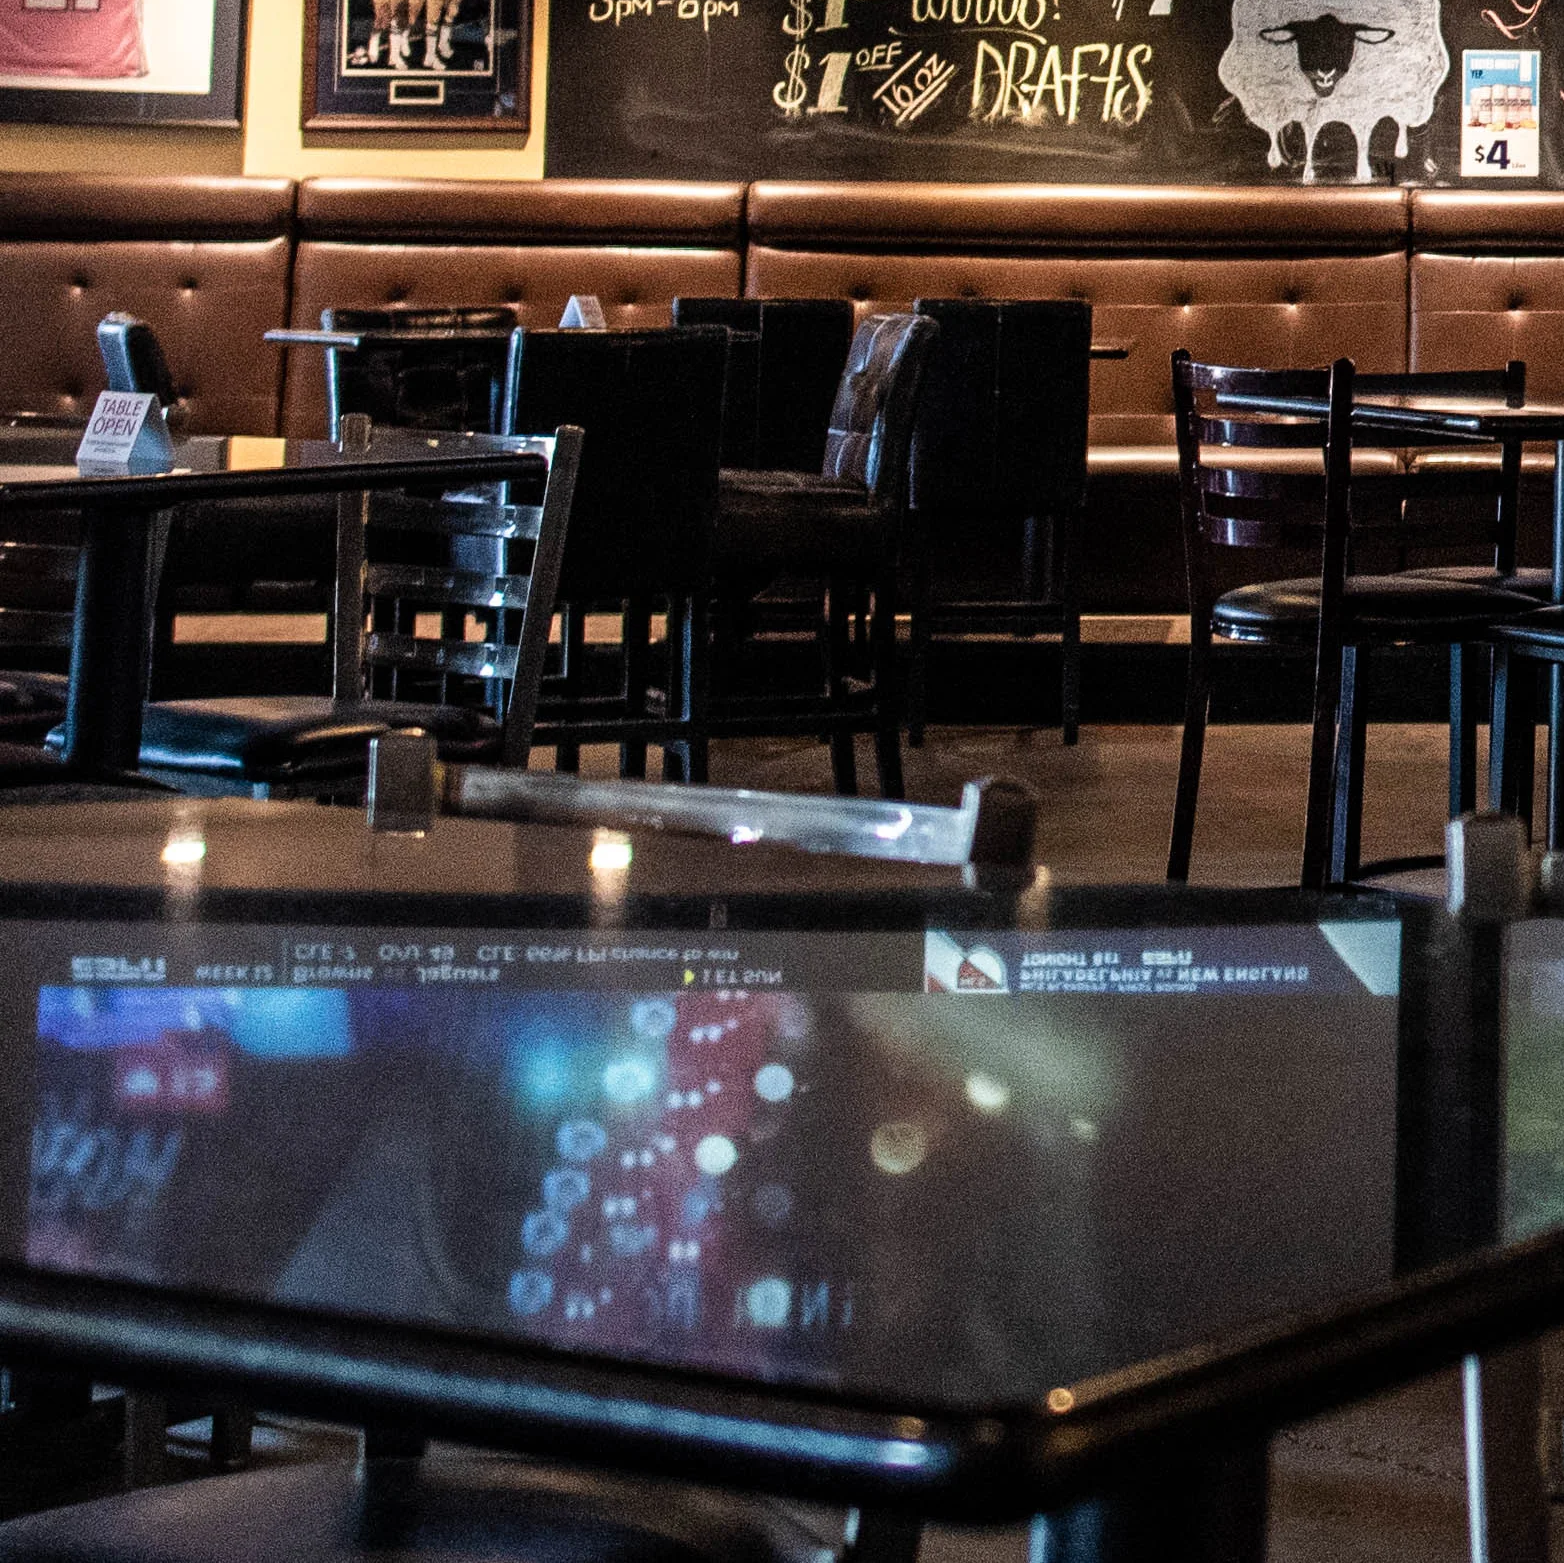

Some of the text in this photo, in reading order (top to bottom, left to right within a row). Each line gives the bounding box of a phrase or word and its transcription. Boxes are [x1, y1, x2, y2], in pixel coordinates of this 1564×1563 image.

[772, 40, 1153, 124] $1 OFF DRAFTS
[1475, 139, 1511, 170] $4
[102, 398, 143, 417] TABLE
[93, 416, 137, 436] OPEN
